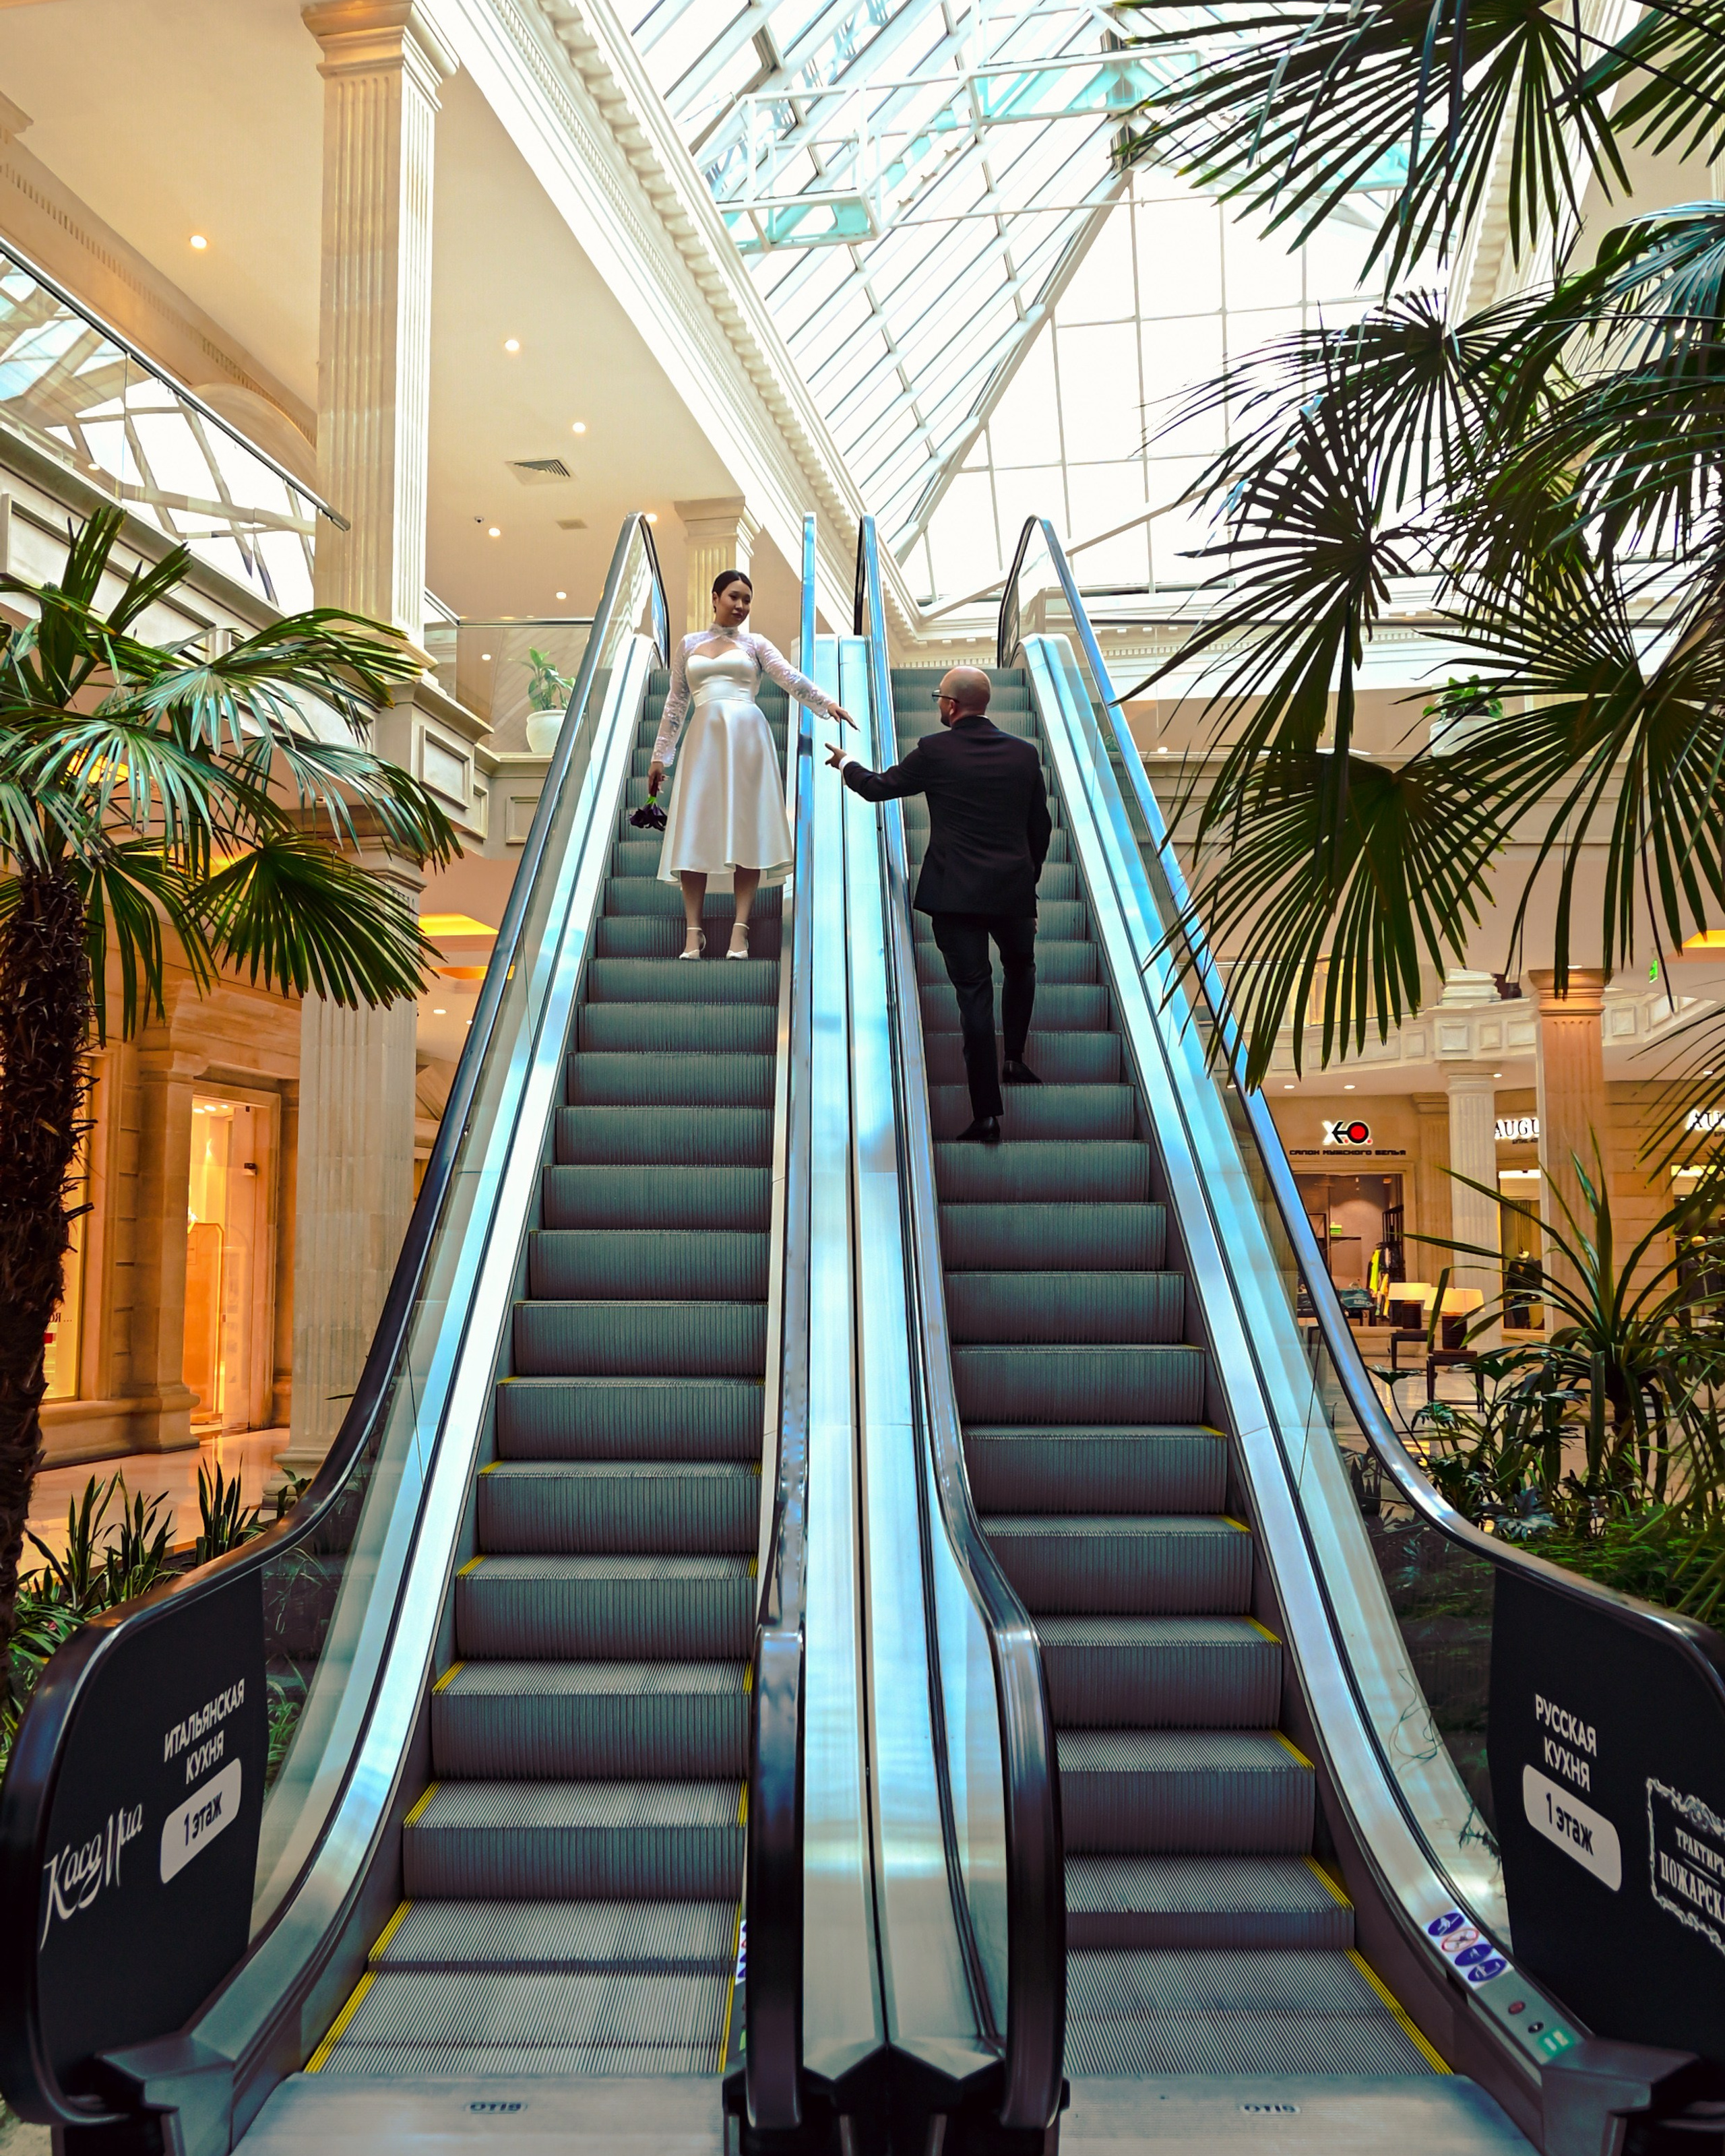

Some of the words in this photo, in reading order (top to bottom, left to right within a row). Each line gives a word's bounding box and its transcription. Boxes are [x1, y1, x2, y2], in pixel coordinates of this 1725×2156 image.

[164, 1678, 245, 1763] ИТАЛЬЯНСКАЯ
[1535, 1693, 1597, 1757] РУССКАЯ
[186, 1730, 224, 1785] КУХНЯ
[1544, 1736, 1590, 1792] КУХНЯ
[184, 1812, 189, 1847] 1
[192, 1791, 222, 1839] этаж
[1546, 1792, 1552, 1825] 1
[1556, 1806, 1594, 1856] этаж
[1660, 1850, 1725, 1924] ПОЖАРСК
